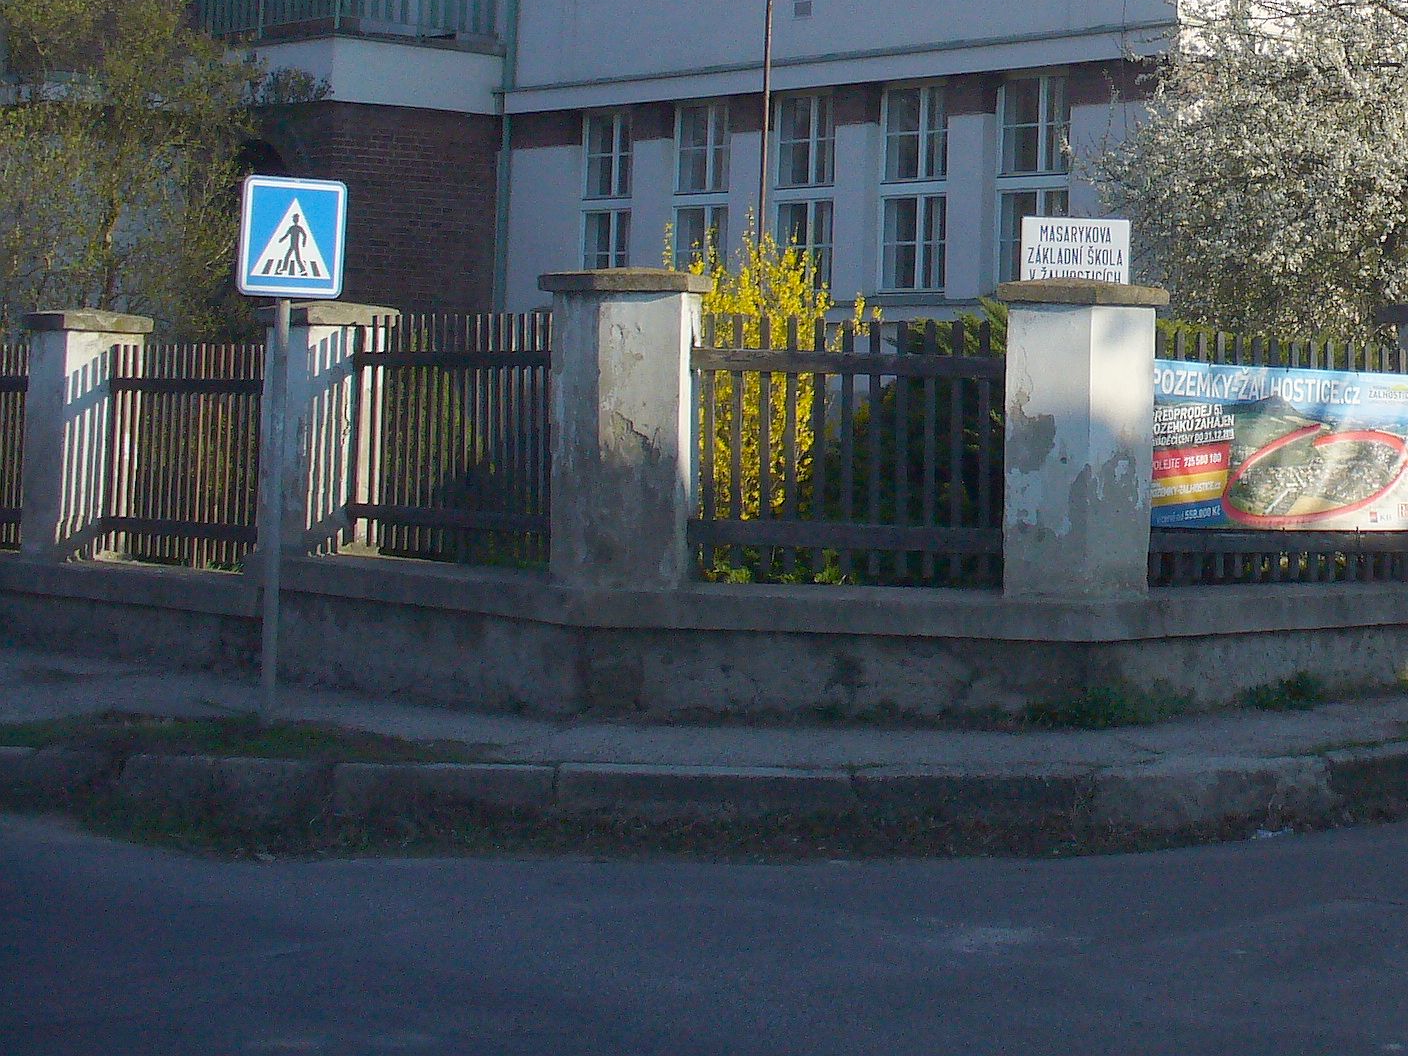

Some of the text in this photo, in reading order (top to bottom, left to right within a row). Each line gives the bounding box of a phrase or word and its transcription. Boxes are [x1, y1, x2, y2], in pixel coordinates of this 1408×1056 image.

[1040, 225, 1111, 244] MASARYKOVA
[1028, 244, 1123, 266] ZÁKLADNÍ ŠKOLA
[1029, 269, 1036, 280] V
[1153, 404, 1212, 422] ŘEDPRODEJ
[1153, 418, 1194, 434] OZEMKŮ
[1152, 458, 1181, 471] OLEJTE
